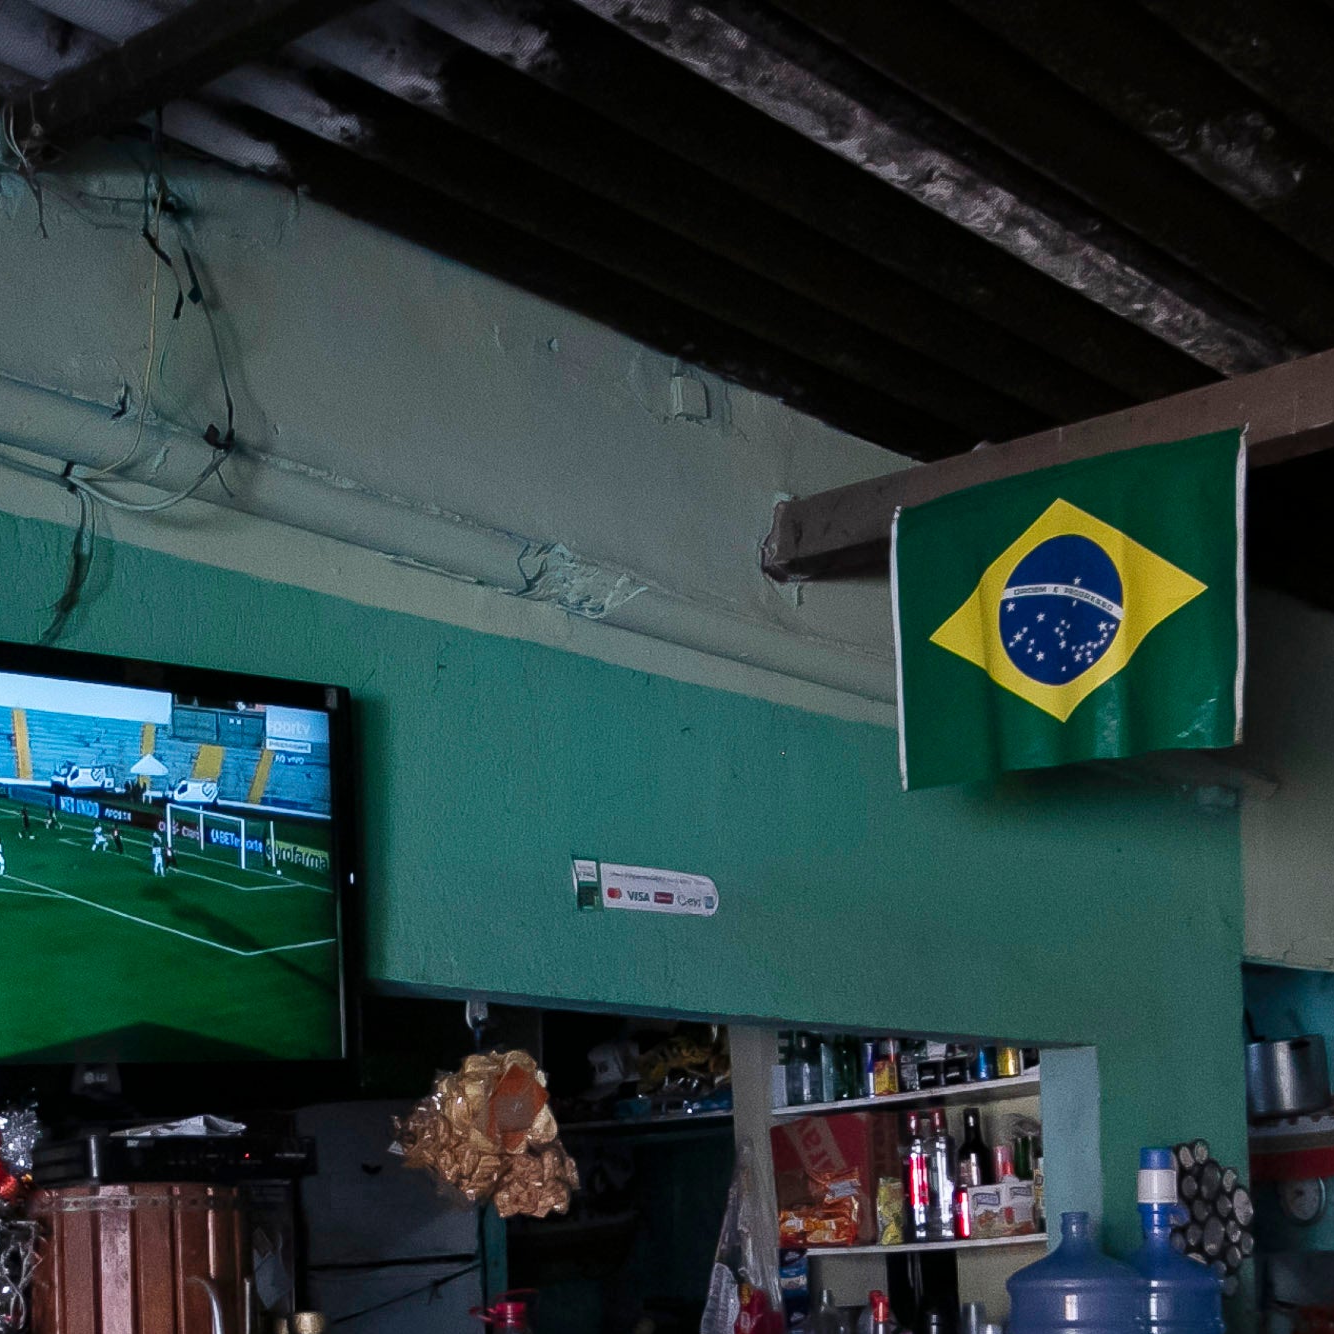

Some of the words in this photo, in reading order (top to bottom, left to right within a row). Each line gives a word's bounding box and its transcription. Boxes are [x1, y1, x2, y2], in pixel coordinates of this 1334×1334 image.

[1013, 586, 1048, 596] ORDEM
[1064, 587, 1114, 612] PROGRESSO
[626, 890, 651, 903] VISA
